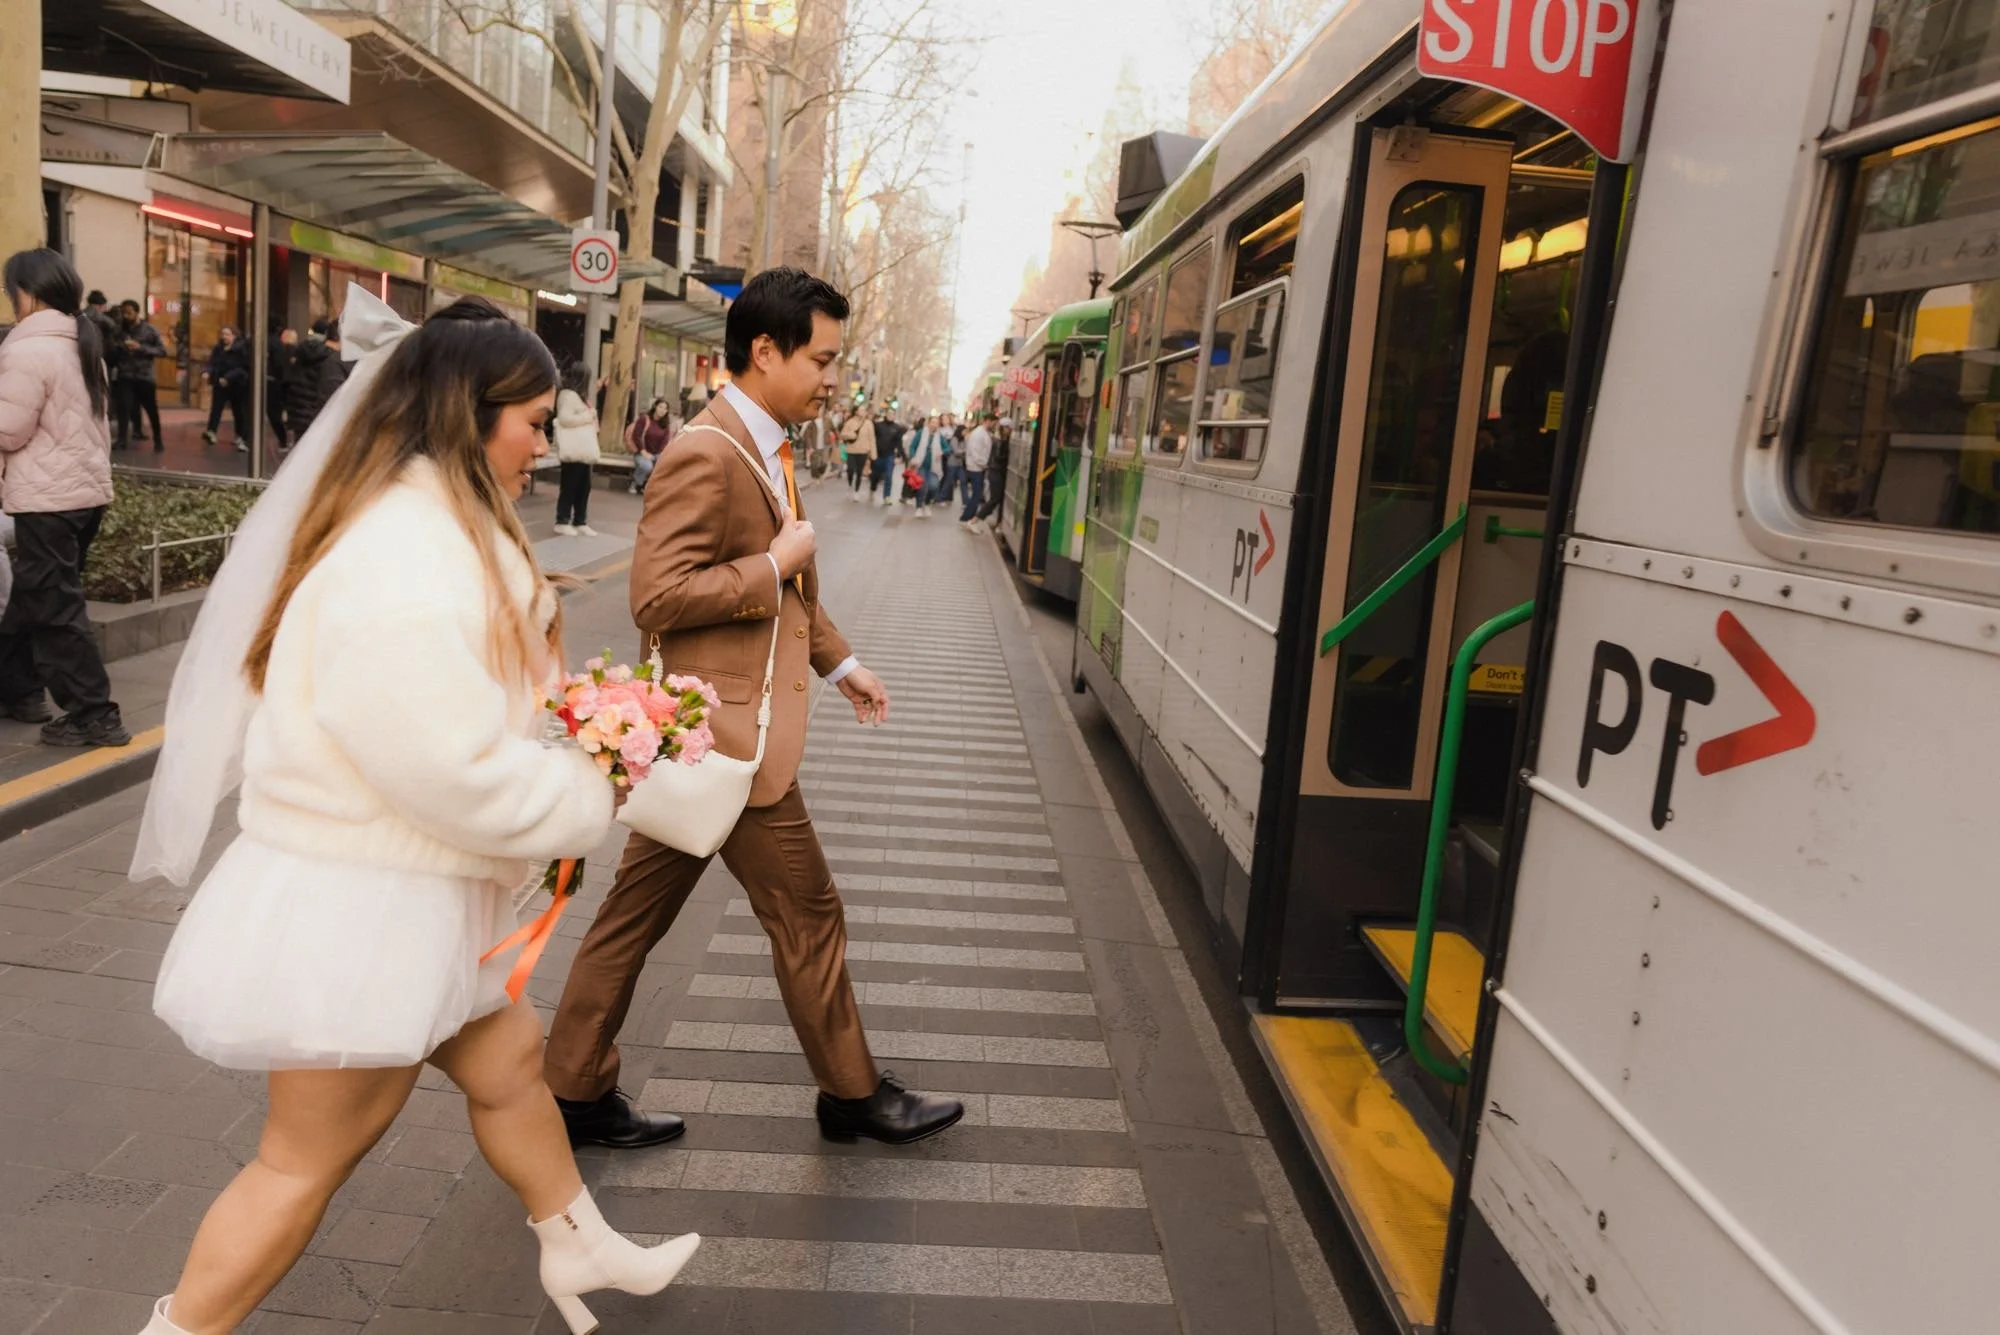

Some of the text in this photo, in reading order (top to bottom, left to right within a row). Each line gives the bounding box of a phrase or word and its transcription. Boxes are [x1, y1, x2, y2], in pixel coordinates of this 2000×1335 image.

[219, 0, 344, 77] JEWELLERY
[1424, 0, 1631, 78] STOP
[581, 250, 609, 271] 30
[1487, 668, 1518, 680] Don't
